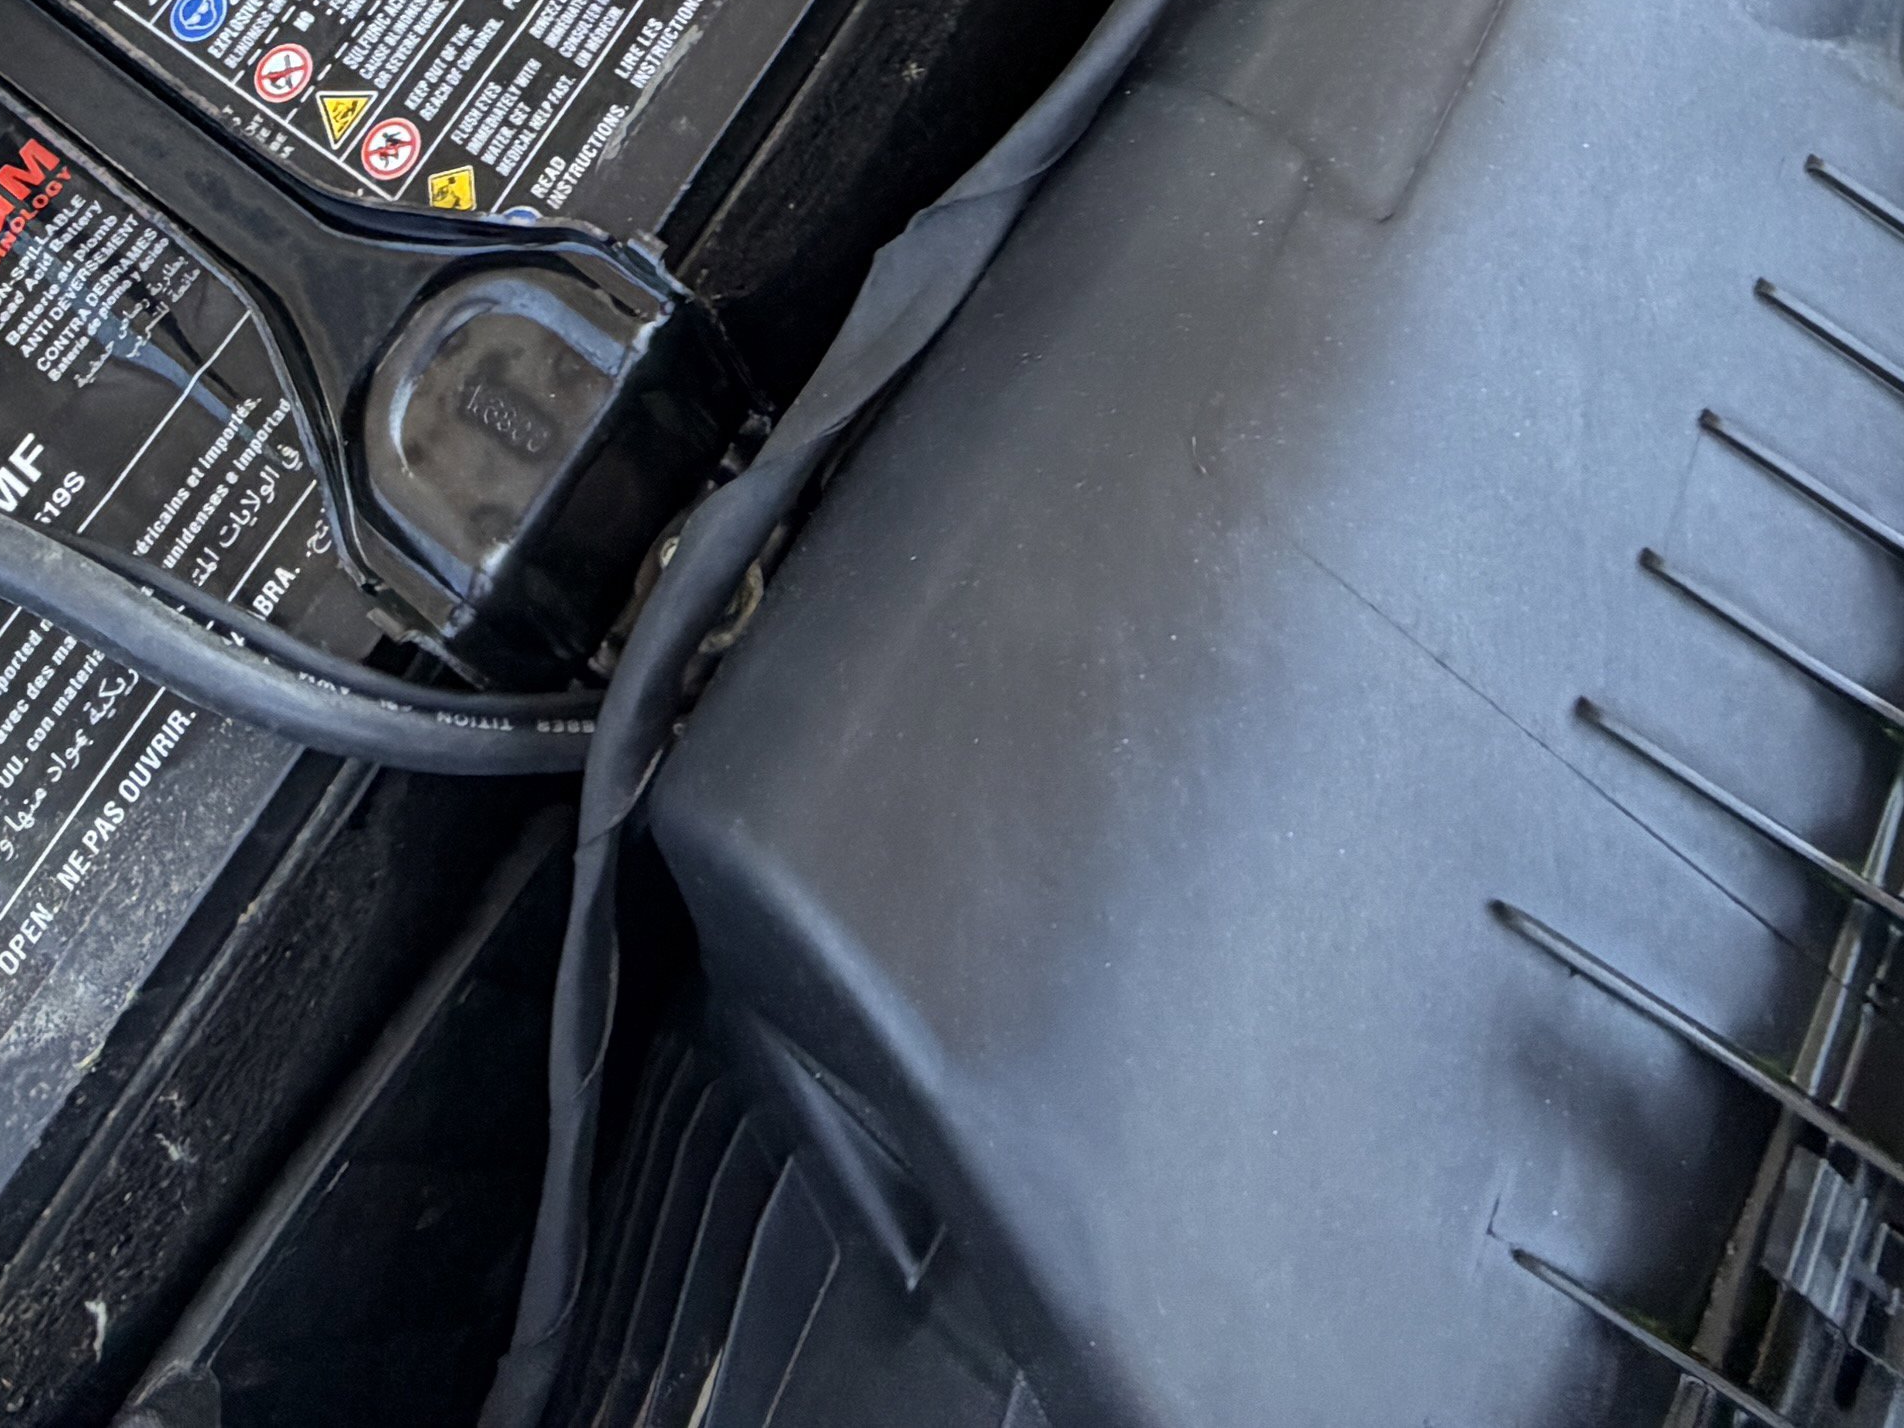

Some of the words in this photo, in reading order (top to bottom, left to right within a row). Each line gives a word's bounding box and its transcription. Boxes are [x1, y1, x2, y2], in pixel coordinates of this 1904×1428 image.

[342, 12, 391, 69] SULFURIC
[404, 79, 429, 110] KEEP
[423, 57, 447, 83] OUT
[449, 23, 474, 46] THE
[614, 43, 645, 78] LIRE
[636, 17, 663, 46] LES
[445, 66, 462, 85] OF
[513, 57, 541, 87] WITH
[450, 107, 483, 144] FLUSH
[474, 81, 502, 111] EYES
[495, 128, 536, 176] MEDICAL
[528, 100, 553, 130] HELP
[546, 74, 576, 104] FAST.
[530, 155, 566, 198] READ
[546, 104, 628, 209] INSTRUCTIONS.
[21, 251, 53, 292] Acid
[48, 199, 102, 264] Battery
[5, 283, 60, 345] Batterie
[56, 259, 74, 283] au
[72, 214, 117, 263] plomb
[36, 308, 91, 371] CONTRA
[84, 216, 157, 307] DERRAMES
[20, 318, 53, 358] ANTI
[34, 470, 85, 523] 19S
[132, 487, 190, 555] éricains
[186, 466, 205, 487] et
[198, 397, 261, 468] importés.
[162, 484, 228, 568] unidenses
[225, 470, 238, 484] e
[232, 398, 293, 471] importad
[249, 567, 300, 621] BRA.
[26, 664, 55, 700] des
[26, 716, 55, 751] con
[51, 649, 105, 716] materia
[435, 711, 513, 731] TITION
[536, 720, 597, 737] BBER
[56, 849, 91, 891] NE
[81, 800, 124, 857] PAS
[118, 697, 195, 802] OUVRIR.
